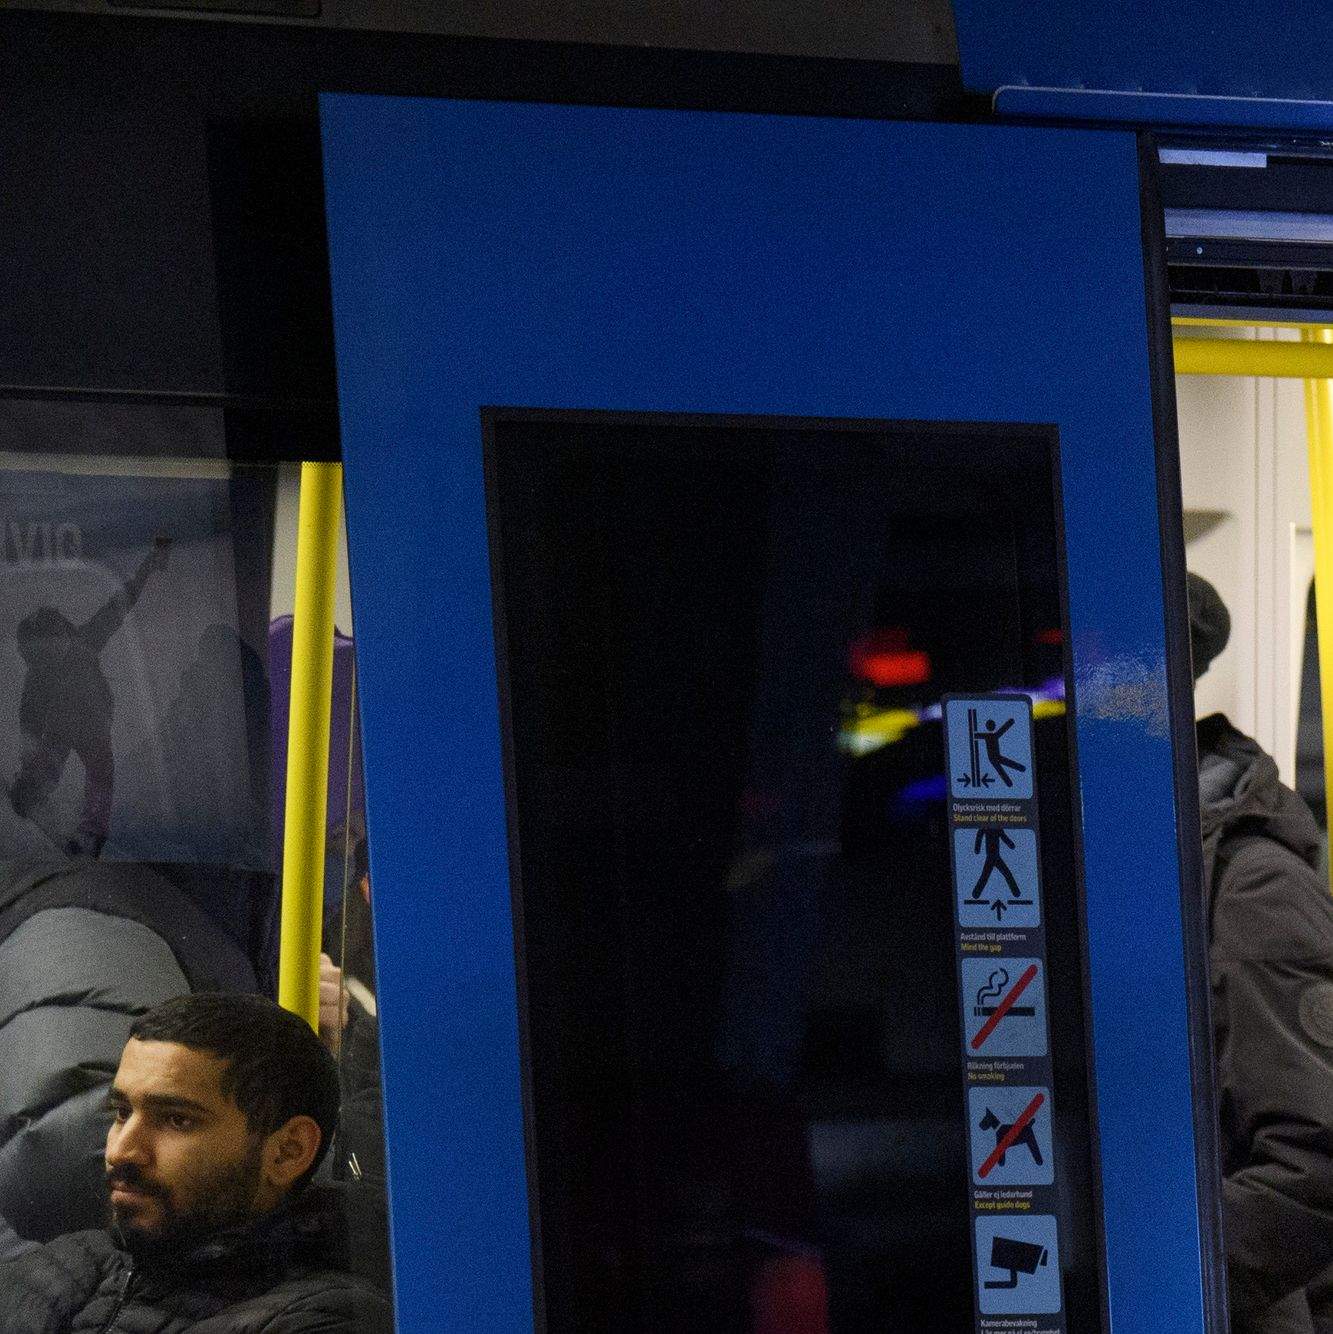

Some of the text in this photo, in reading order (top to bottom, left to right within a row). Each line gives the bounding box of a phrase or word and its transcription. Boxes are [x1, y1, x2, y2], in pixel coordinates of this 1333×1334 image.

[986, 804, 1000, 812] med
[953, 814, 1027, 823] Stand clear of the doors
[996, 932, 1026, 942] plattform
[960, 943, 977, 951] Mind
[978, 943, 989, 951] the
[968, 1072, 1004, 1081] No smoking
[975, 1200, 1030, 1210] Except guide dogs
[980, 1319, 1037, 1328] Kamerabevakning
